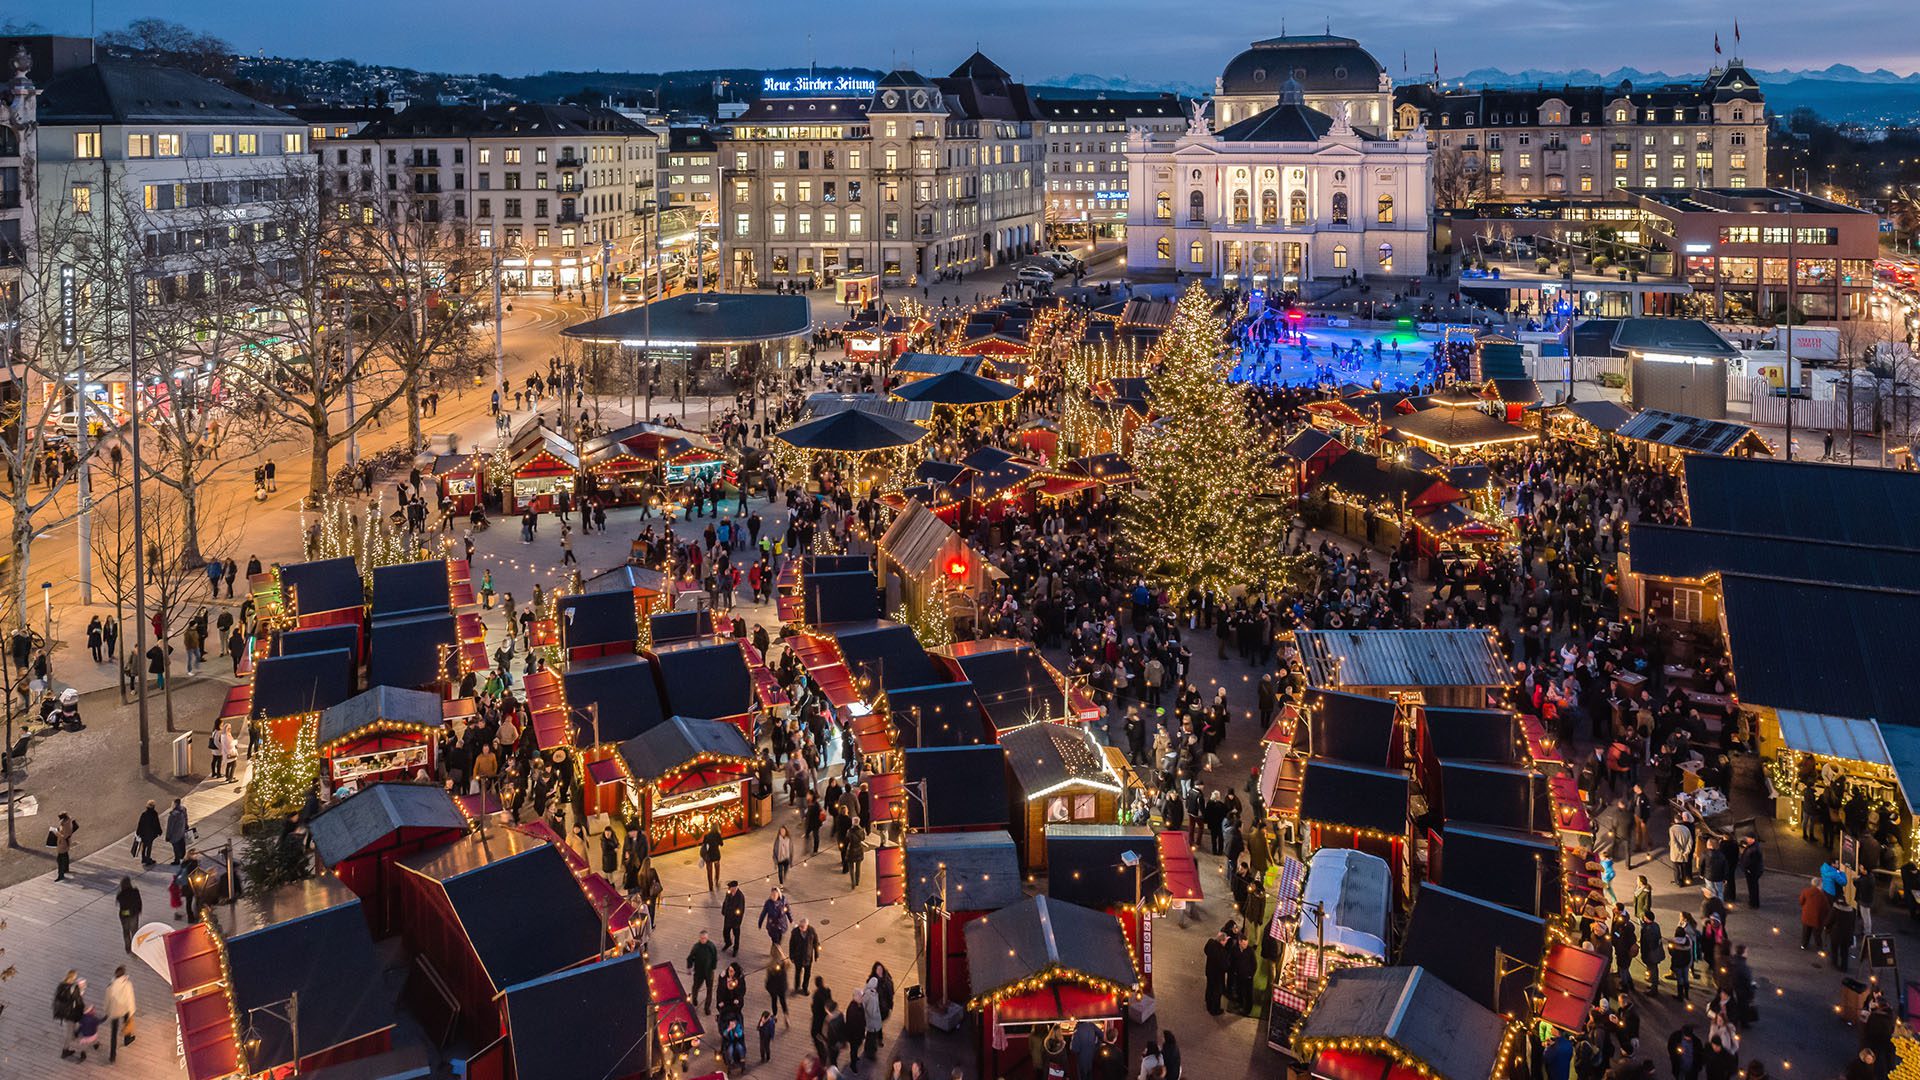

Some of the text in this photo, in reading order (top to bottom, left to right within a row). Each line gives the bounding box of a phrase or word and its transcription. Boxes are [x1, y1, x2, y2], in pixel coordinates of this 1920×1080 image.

[764, 76, 875, 94] Neue Zürcher Zeitung
